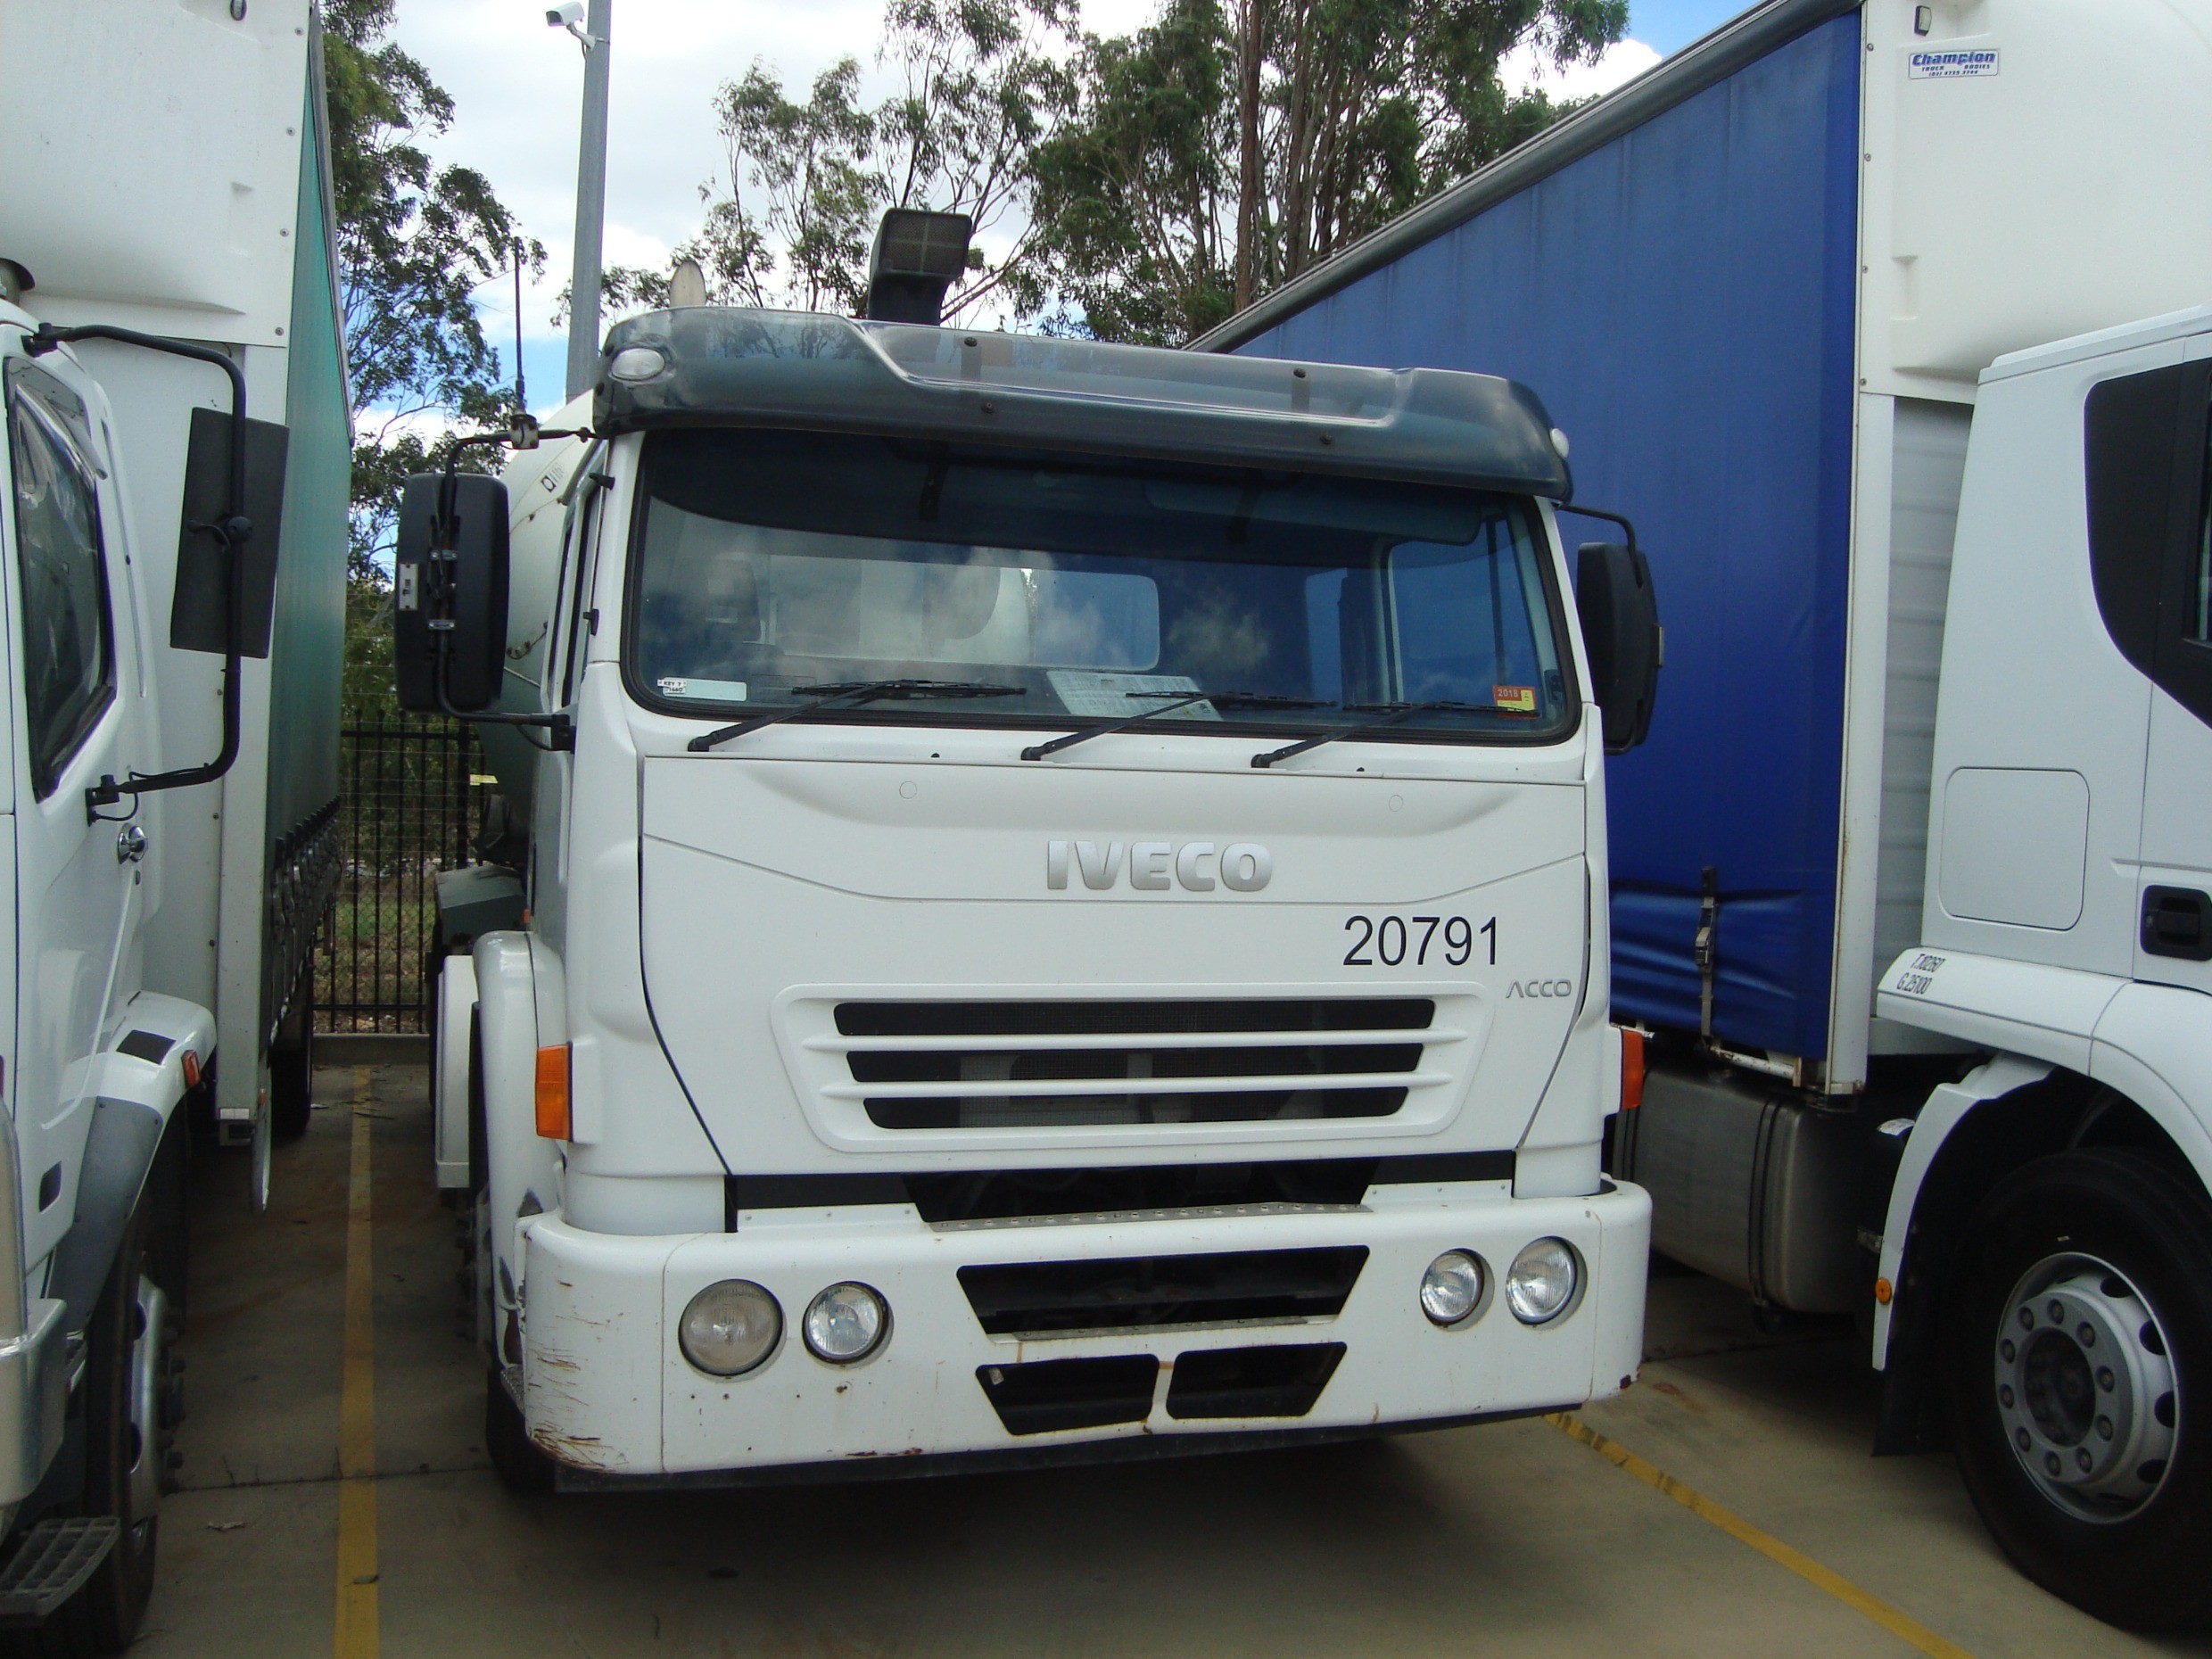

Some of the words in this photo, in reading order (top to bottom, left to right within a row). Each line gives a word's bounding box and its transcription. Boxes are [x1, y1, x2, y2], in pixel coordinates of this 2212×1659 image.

[1912, 52, 1995, 66] Champion
[1046, 840, 1274, 892] IVECO
[1342, 915, 1497, 966] 20791
[1505, 978, 1572, 999] ACCO
